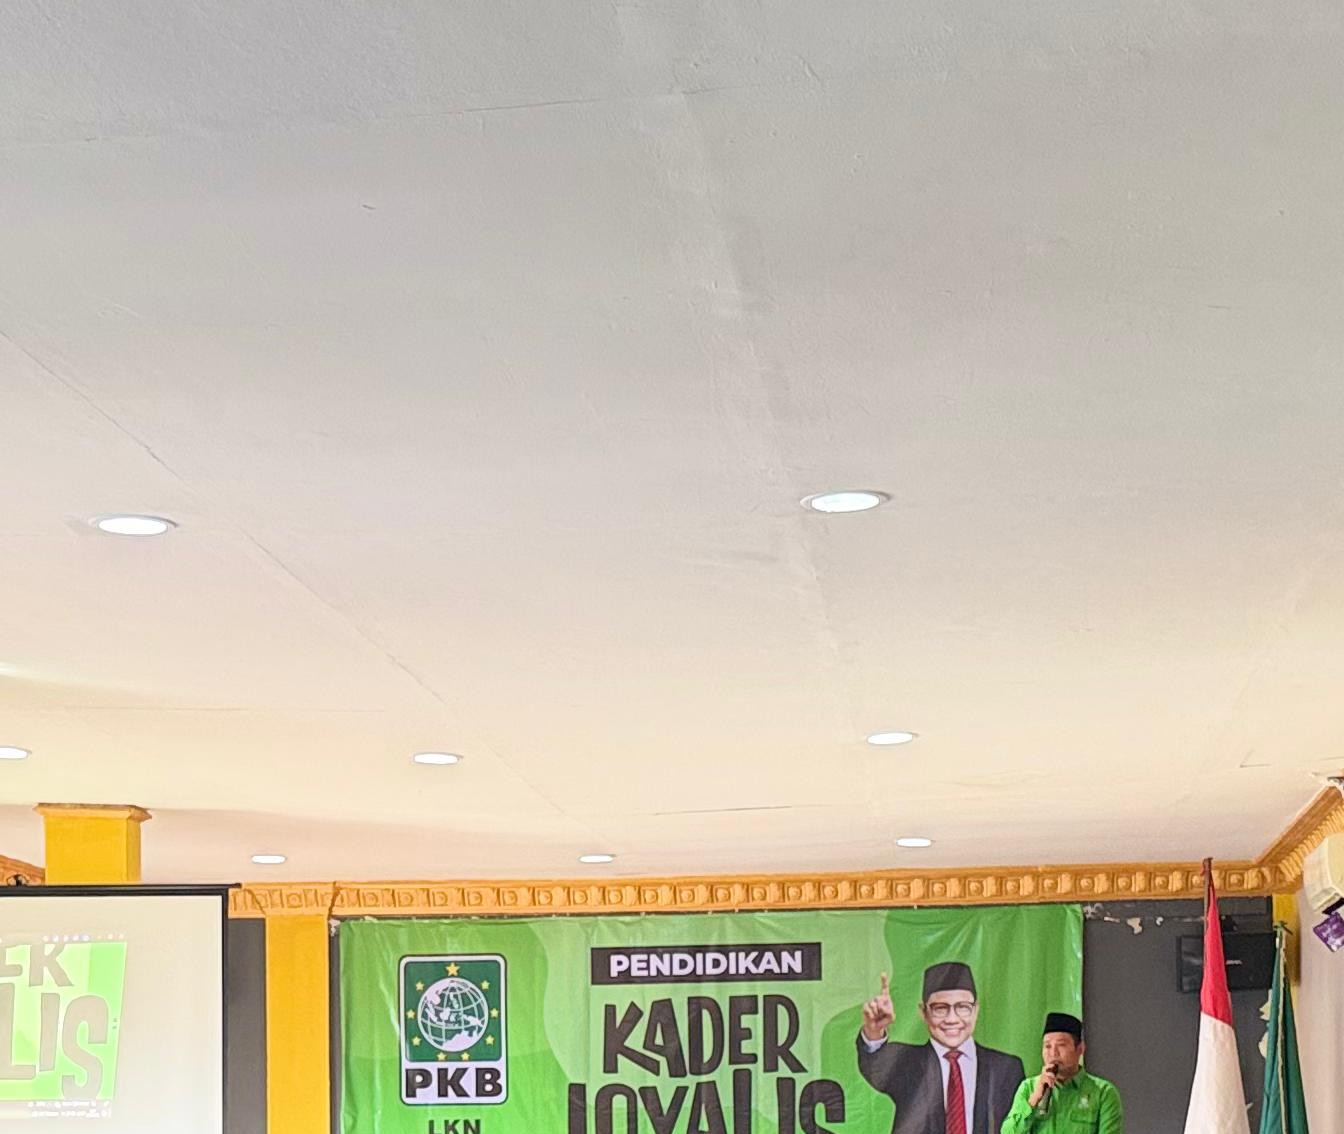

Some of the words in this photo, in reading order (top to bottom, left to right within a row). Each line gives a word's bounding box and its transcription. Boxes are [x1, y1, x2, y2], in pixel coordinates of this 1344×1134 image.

[609, 950, 803, 978] PENDIDIKAN
[602, 994, 808, 1079] KADER
[405, 1067, 503, 1099] PKB
